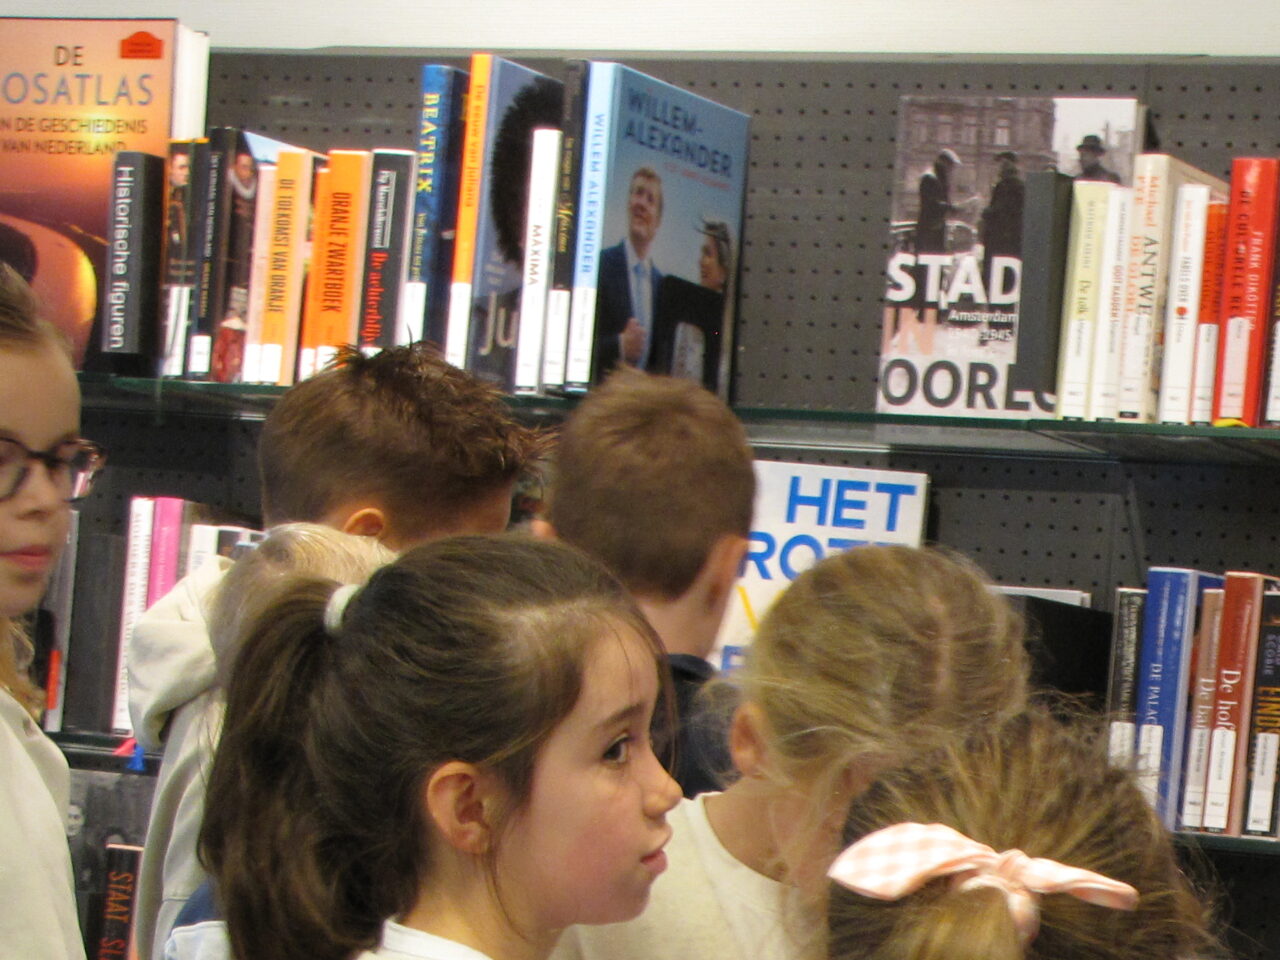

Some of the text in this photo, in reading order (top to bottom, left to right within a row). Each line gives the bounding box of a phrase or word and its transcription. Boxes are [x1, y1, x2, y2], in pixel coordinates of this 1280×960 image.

[55, 45, 84, 66] DE
[15, 117, 148, 134] DE GESCHIEDENIS
[416, 92, 439, 192] BEATRIX
[470, 104, 482, 136] eeuw
[468, 140, 478, 162] van
[624, 118, 733, 178] ALEXANDER
[582, 113, 604, 272] WILLEM ALEXANDER
[108, 165, 134, 348] Historische figuren
[267, 178, 294, 314] DE TOEKOMST VAN ORANJE
[321, 190, 353, 314] ORANJE ZWARTBOEK
[1248, 231, 1261, 268] FRANK
[884, 251, 1023, 305] STAD
[883, 307, 936, 355] IN
[881, 358, 1056, 413] OORL
[785, 475, 918, 532] HET
[1148, 661, 1163, 680] DE
[1262, 633, 1276, 674] SCOBIE
[1197, 677, 1215, 697] De
[1219, 668, 1241, 693] De
[102, 869, 134, 923] STAAT
